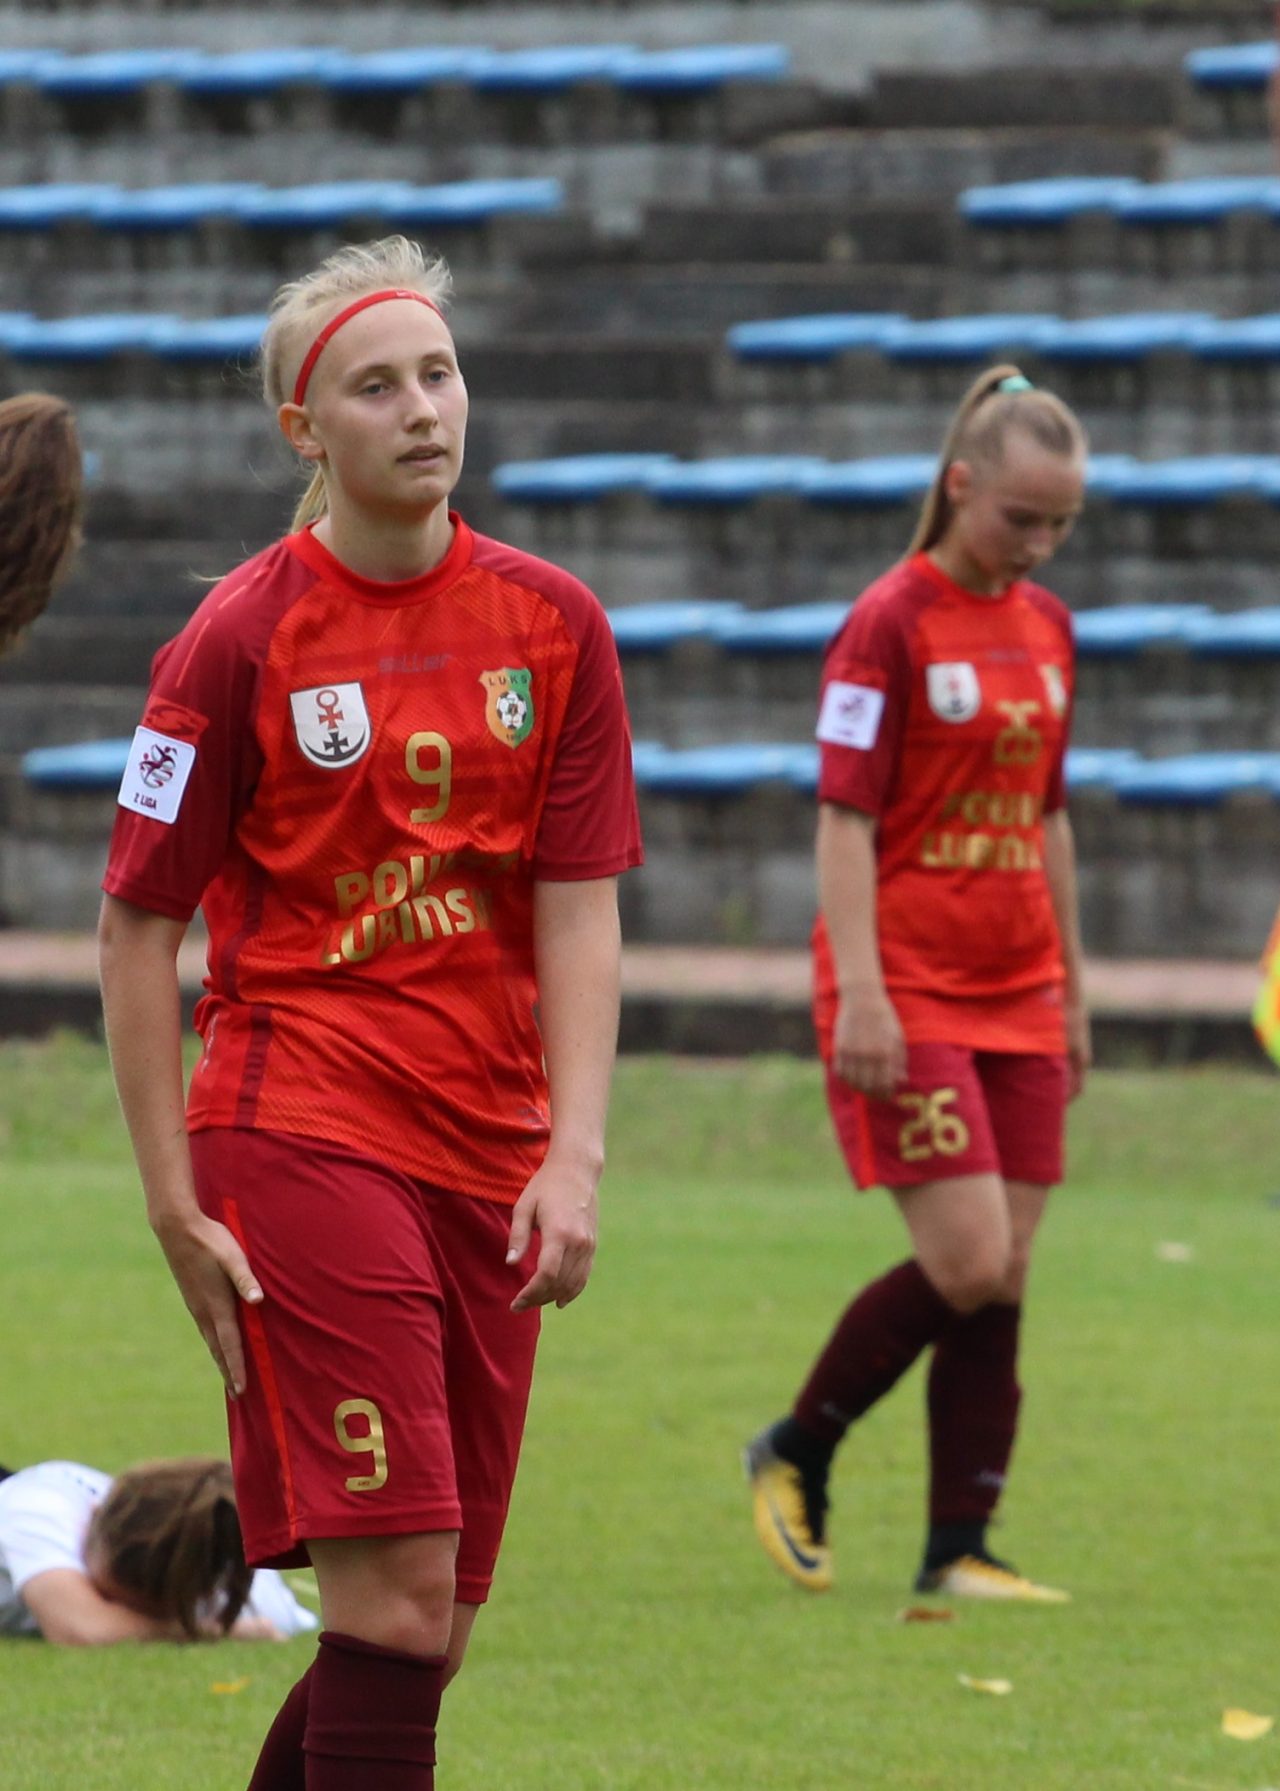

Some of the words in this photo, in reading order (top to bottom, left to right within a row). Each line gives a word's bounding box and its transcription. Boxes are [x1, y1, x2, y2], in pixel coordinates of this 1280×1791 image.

[488, 674, 528, 686] LUKS
[140, 794, 158, 811] LIGA
[405, 731, 452, 824] 9
[897, 1087, 970, 1162] 26
[333, 1398, 388, 1492] 9
